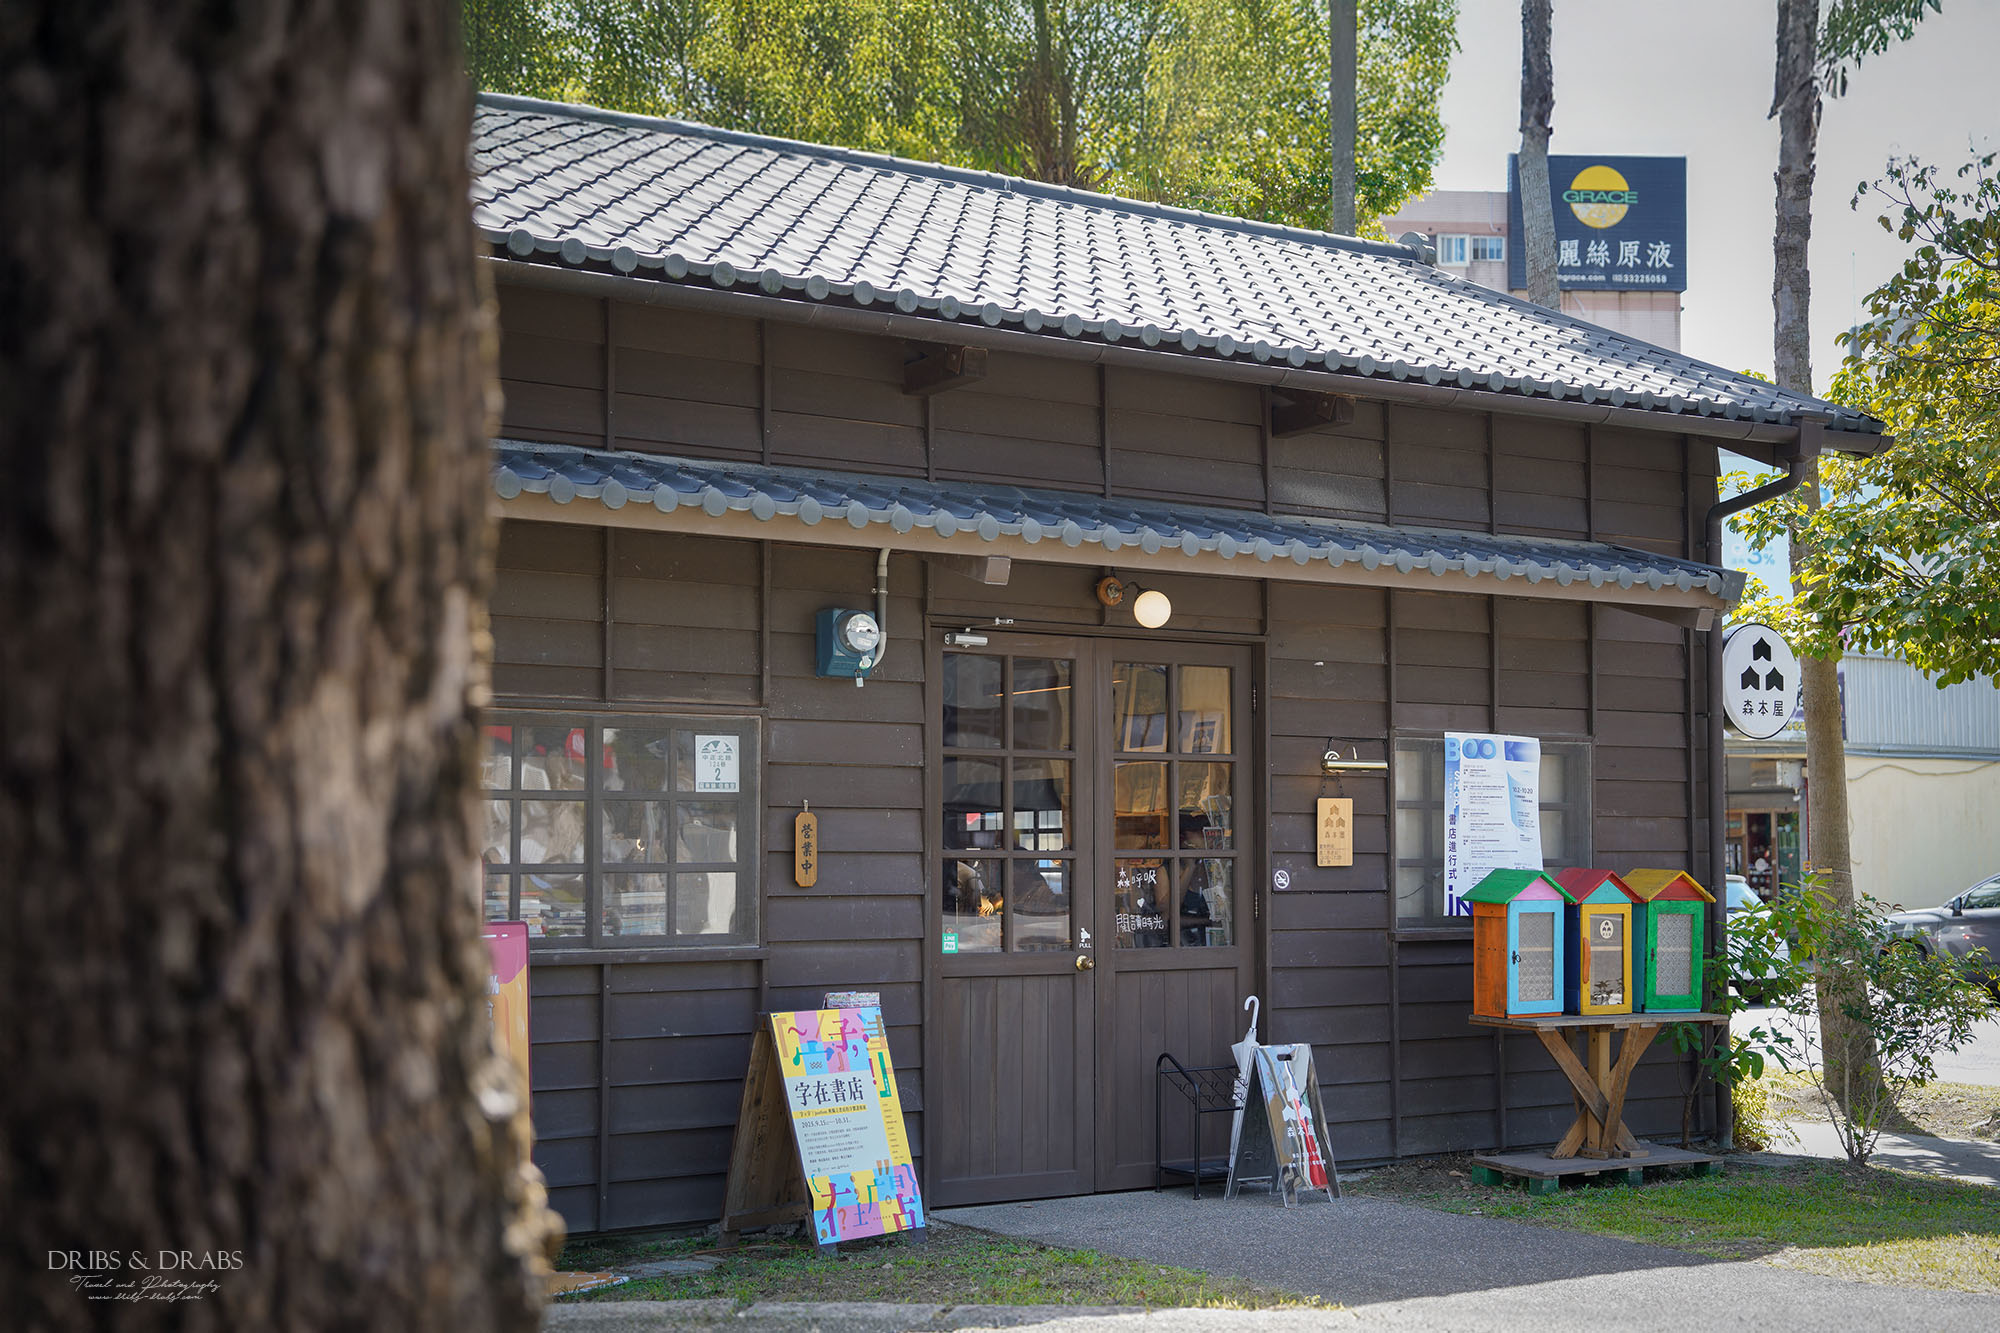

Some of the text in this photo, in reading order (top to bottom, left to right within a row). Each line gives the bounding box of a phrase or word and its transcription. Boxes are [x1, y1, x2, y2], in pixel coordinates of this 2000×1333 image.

[1562, 190, 1638, 204] GRACE
[1557, 239, 1674, 268] 麗絲原液
[1742, 699, 1784, 717] 森本屋
[715, 767, 721, 781] 2
[1448, 814, 1457, 880] 書店進行式
[1117, 867, 1157, 888] 森呼吸
[795, 1077, 864, 1106] 字在書店
